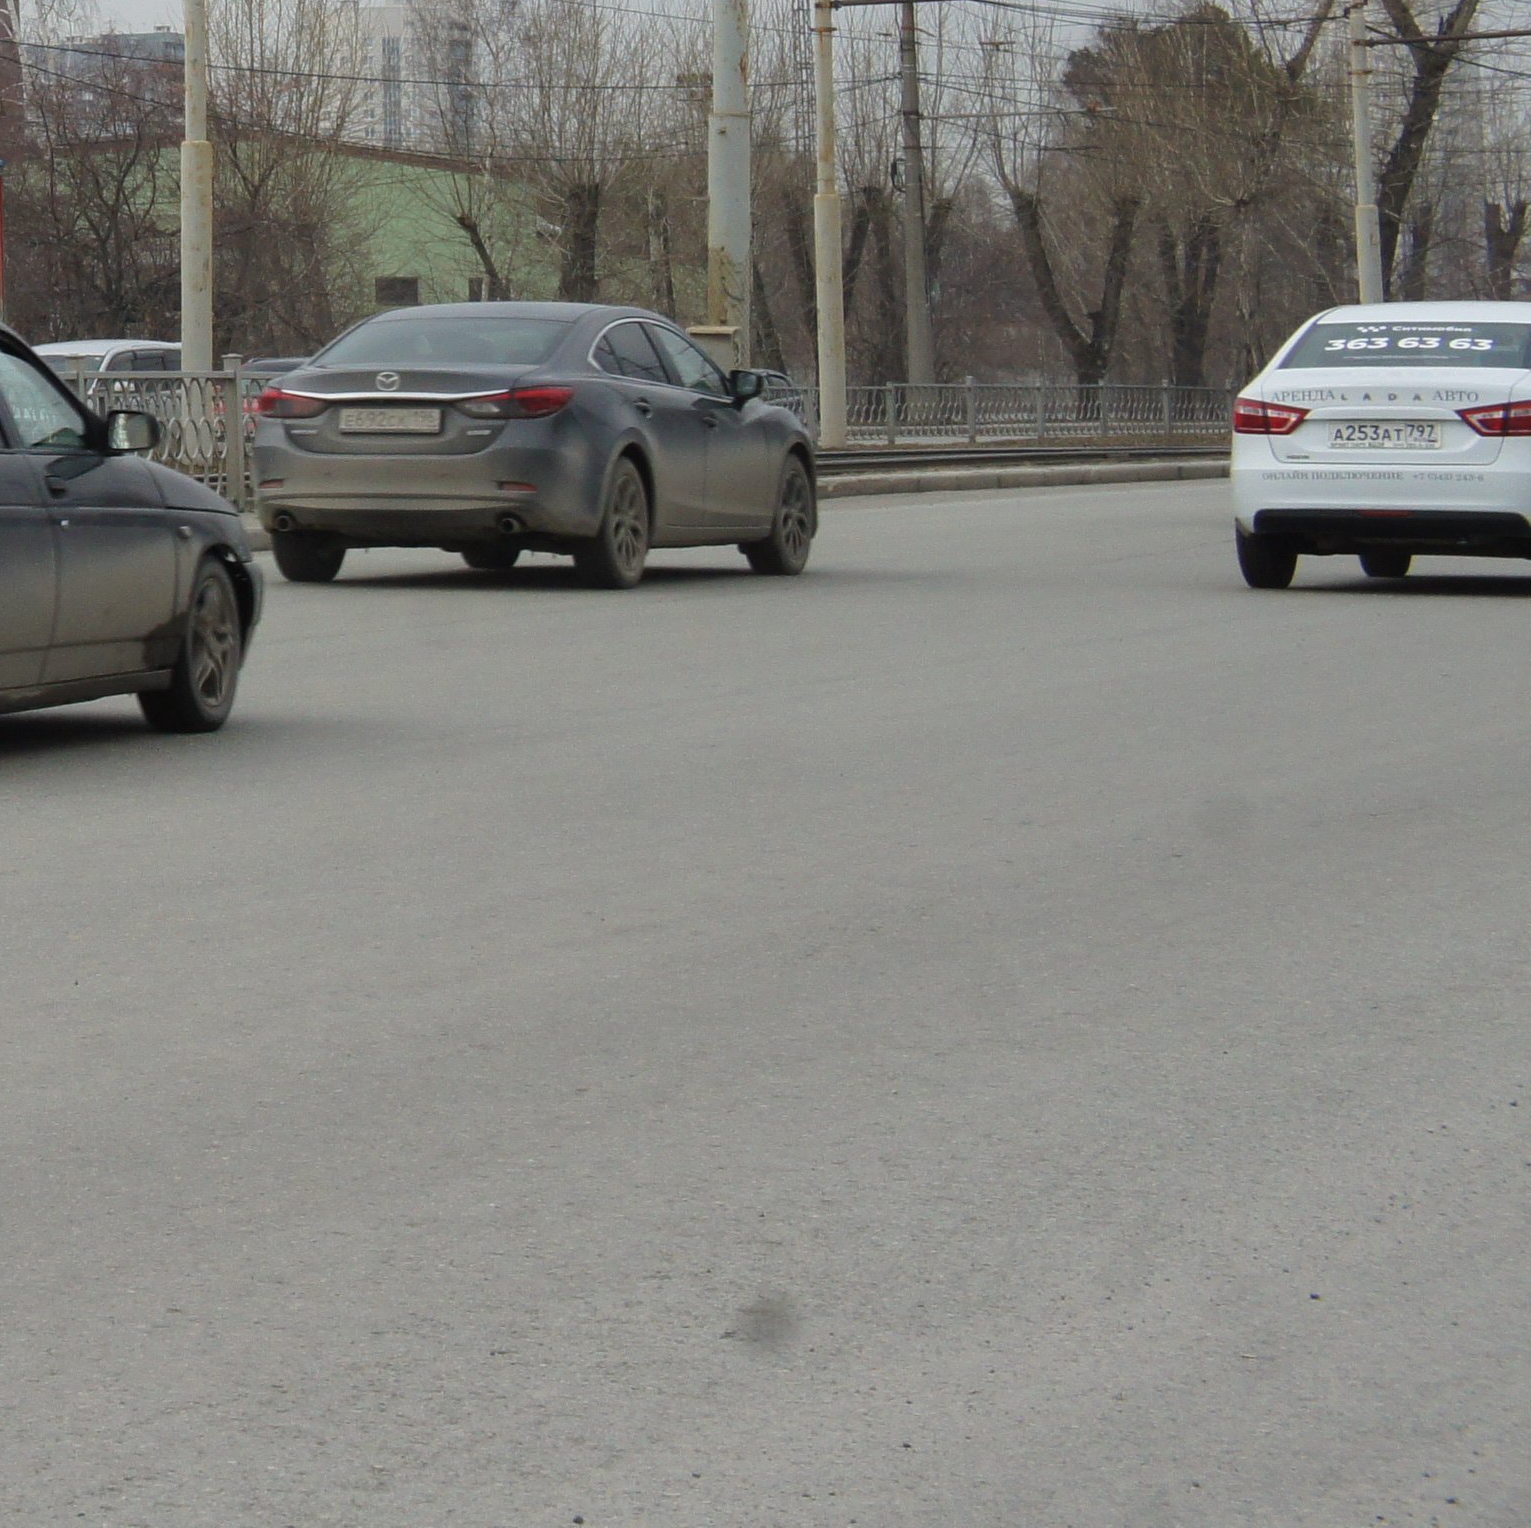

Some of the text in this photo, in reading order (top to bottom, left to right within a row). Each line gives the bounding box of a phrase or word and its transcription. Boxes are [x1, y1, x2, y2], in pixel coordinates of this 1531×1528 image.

[1324, 337, 1493, 351] 363 63 63
[1271, 389, 1479, 403] АРЕНДА АВТО
[1334, 424, 1435, 441] А253АТ 797
[1262, 471, 1308, 480] ОНЛАЙН
[1312, 471, 1403, 480] ПОДКЛЮЧЕНИЕ
